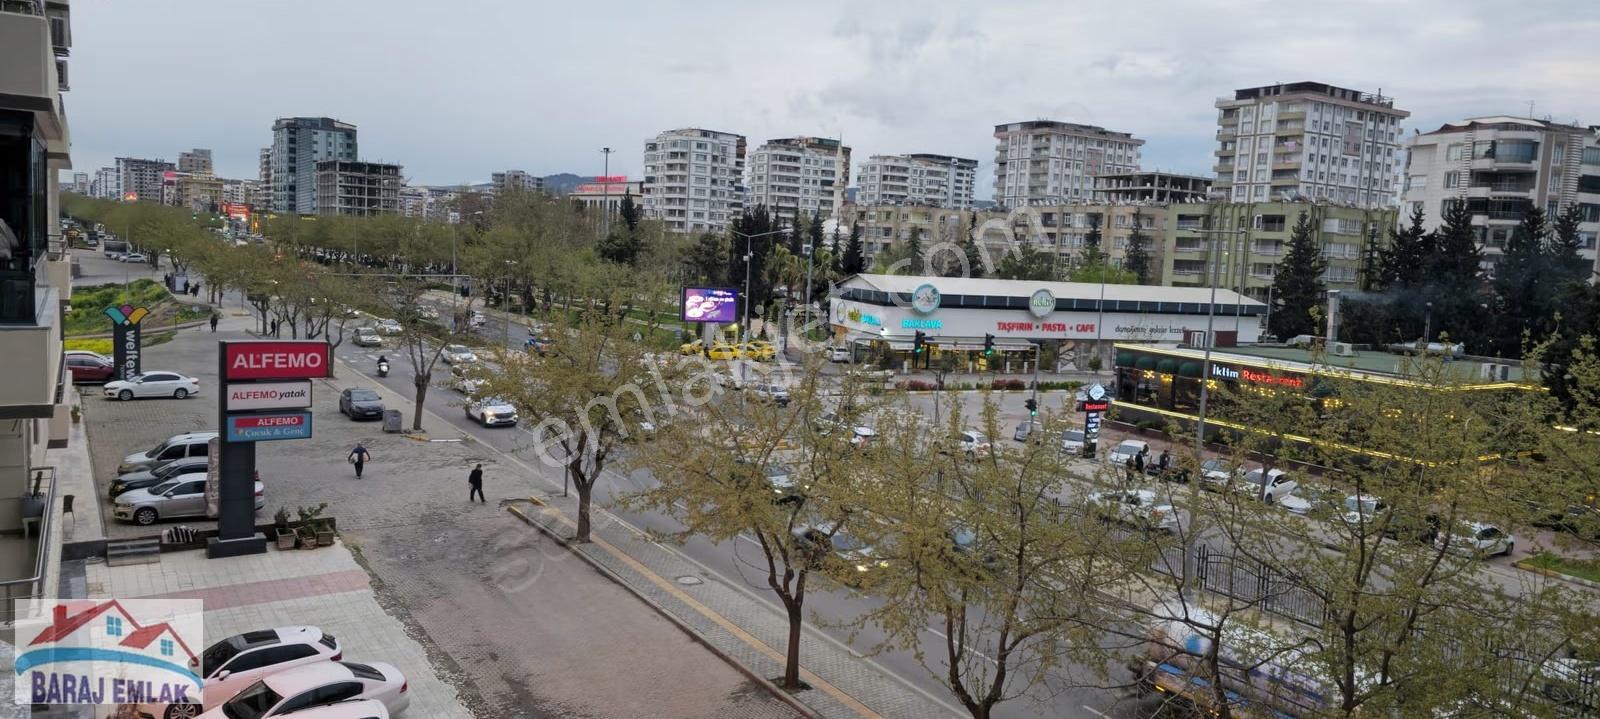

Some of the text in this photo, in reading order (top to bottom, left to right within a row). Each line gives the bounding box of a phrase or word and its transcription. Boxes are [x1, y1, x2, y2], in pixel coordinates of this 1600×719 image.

[902, 319, 943, 329] BAKLAVA
[997, 321, 1095, 333] TAŞFIRIN PASTA CAFE
[232, 352, 322, 369] ALFEMO
[231, 389, 306, 401] ALFEMO yatak
[257, 417, 299, 426] ALFEMO
